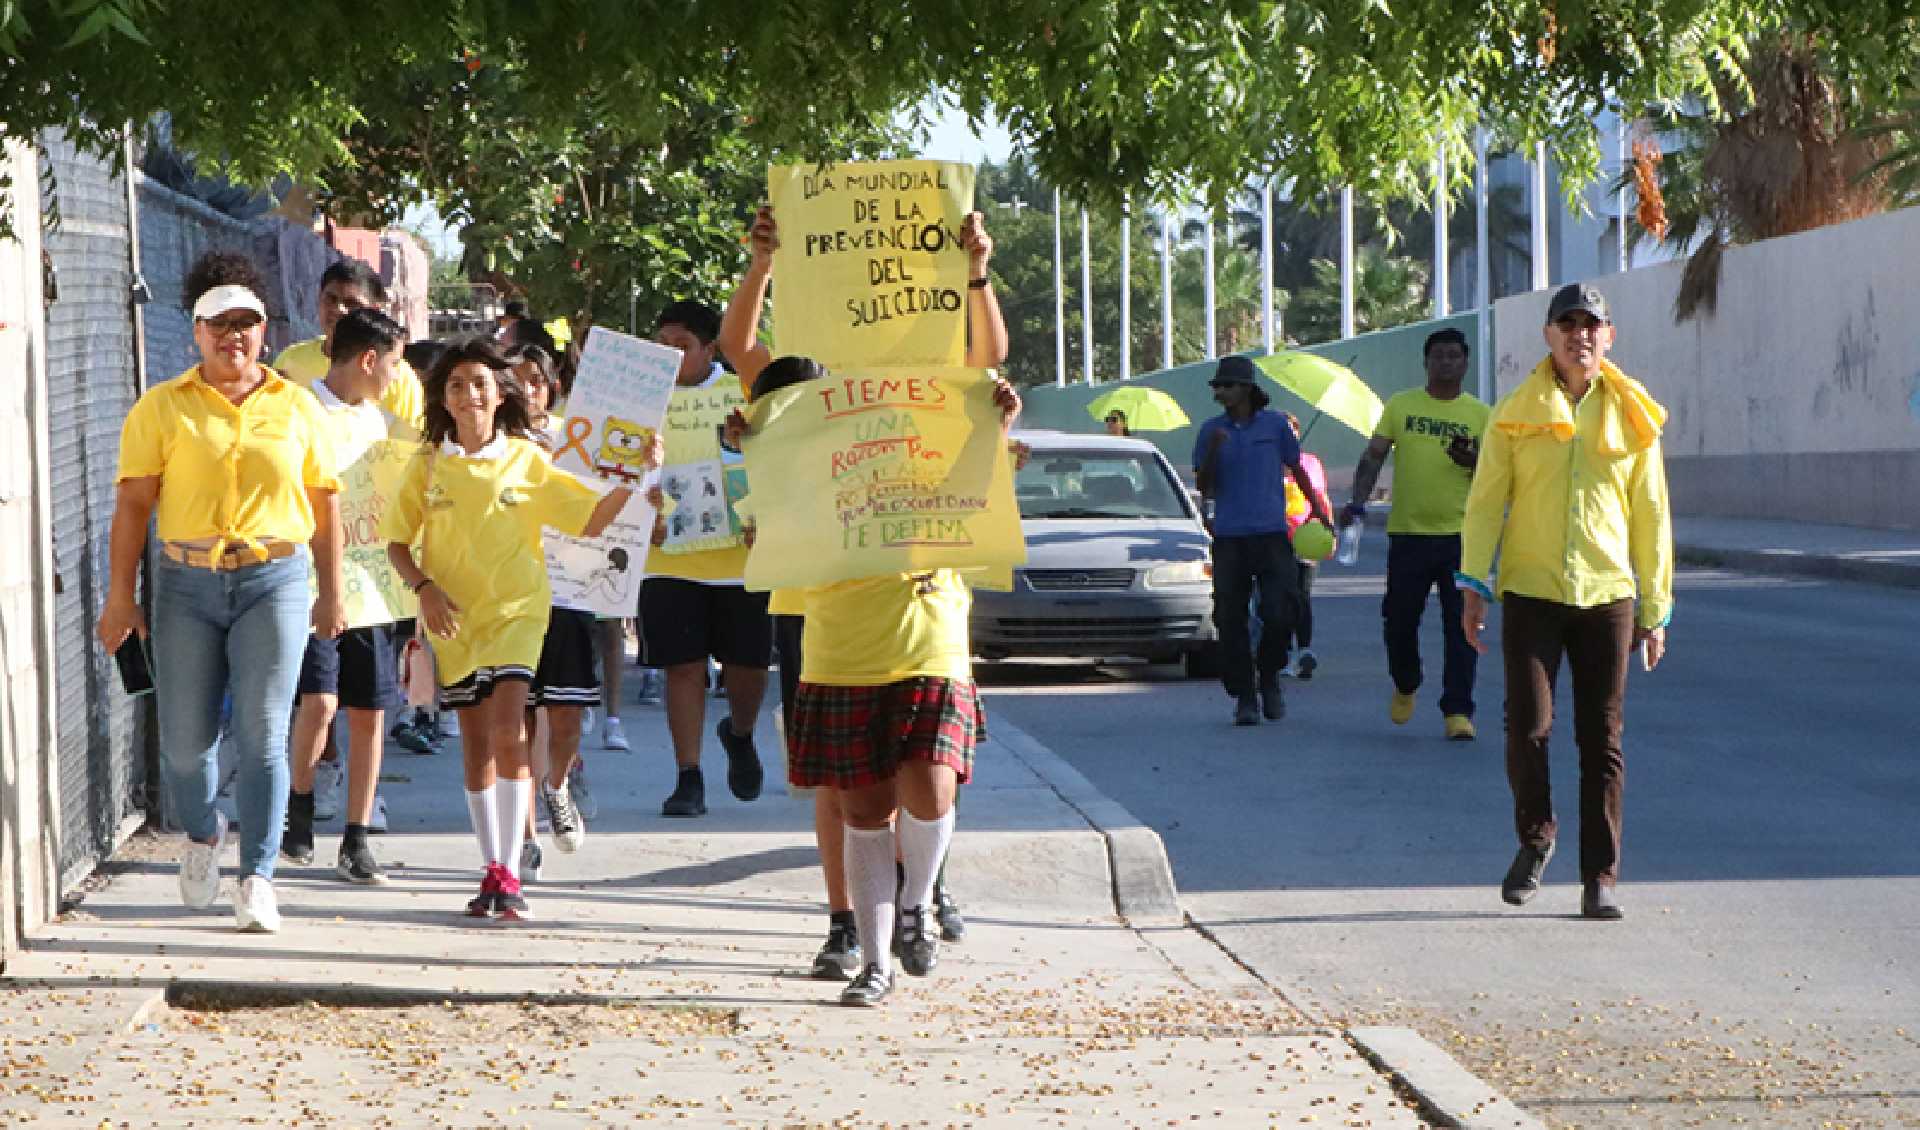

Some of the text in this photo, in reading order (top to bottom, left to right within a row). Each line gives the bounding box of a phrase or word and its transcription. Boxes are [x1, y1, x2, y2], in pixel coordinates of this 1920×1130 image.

[846, 170, 949, 191] MUNDIAL
[853, 198, 925, 223] DE LA
[805, 217, 964, 257] PREVENCIÓN
[868, 256, 913, 286] DEL
[846, 286, 962, 327] SUICIDIO
[856, 412, 922, 440] UNA
[881, 519, 974, 545] DEFINA
